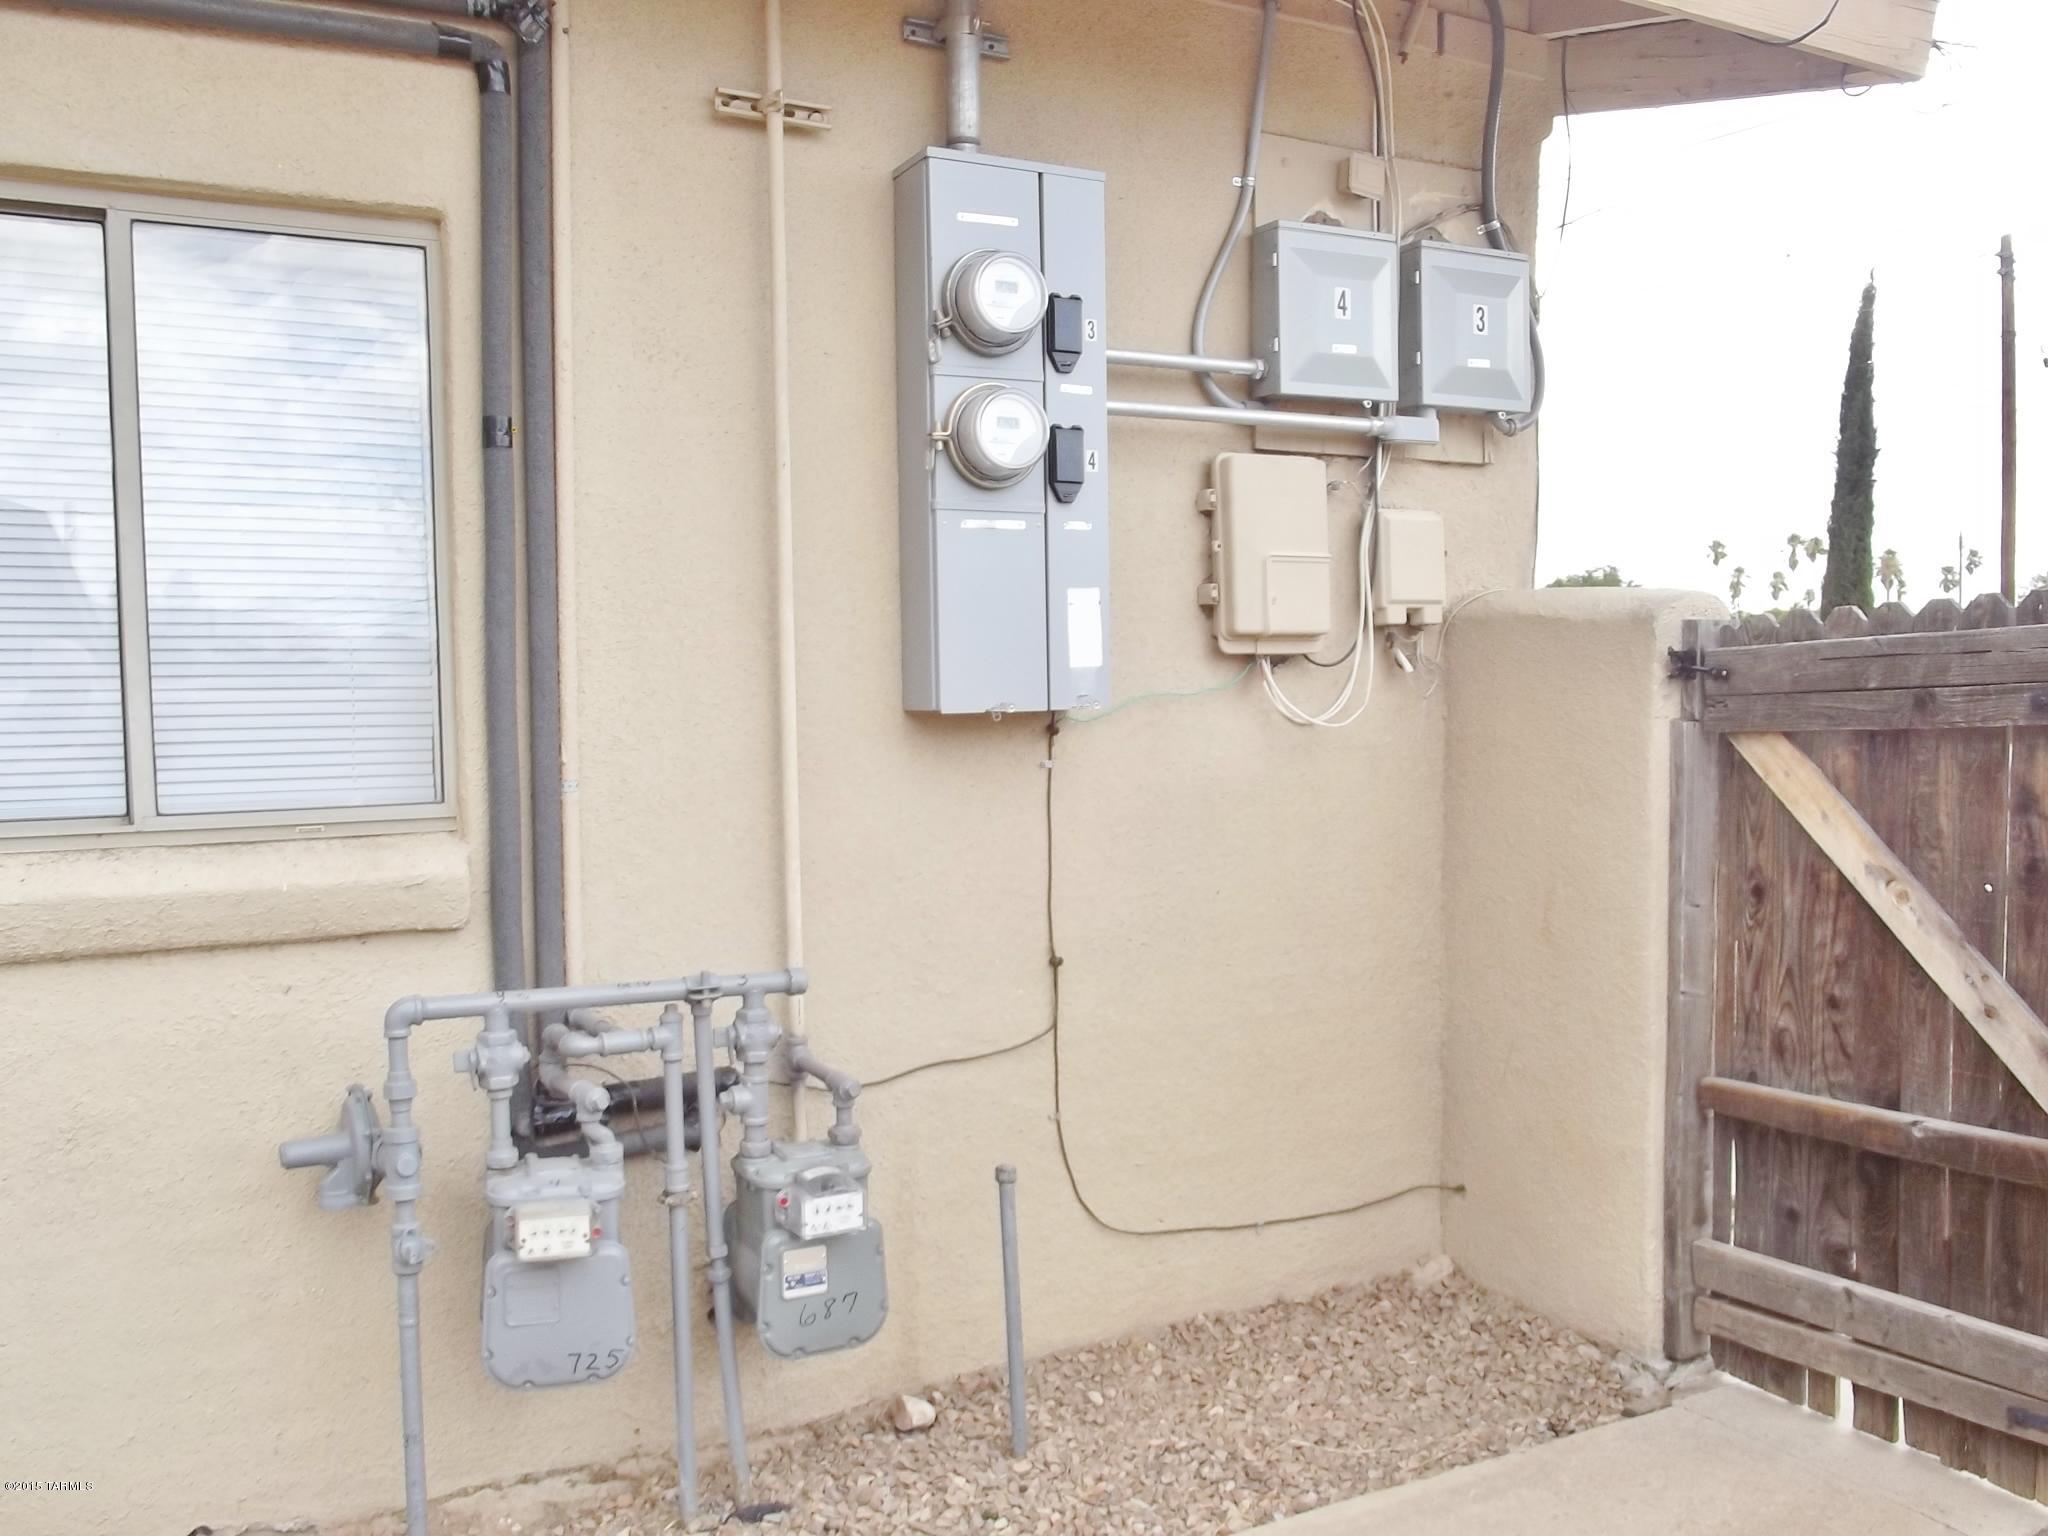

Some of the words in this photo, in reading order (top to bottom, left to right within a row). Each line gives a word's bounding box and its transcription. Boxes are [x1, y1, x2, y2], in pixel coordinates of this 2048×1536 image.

[1337, 289, 1348, 317] 4
[1086, 320, 1096, 340] 3
[1476, 306, 1485, 333] 3
[1087, 451, 1097, 471] 4
[799, 1291, 858, 1327] 687
[567, 1348, 625, 1375] 725
